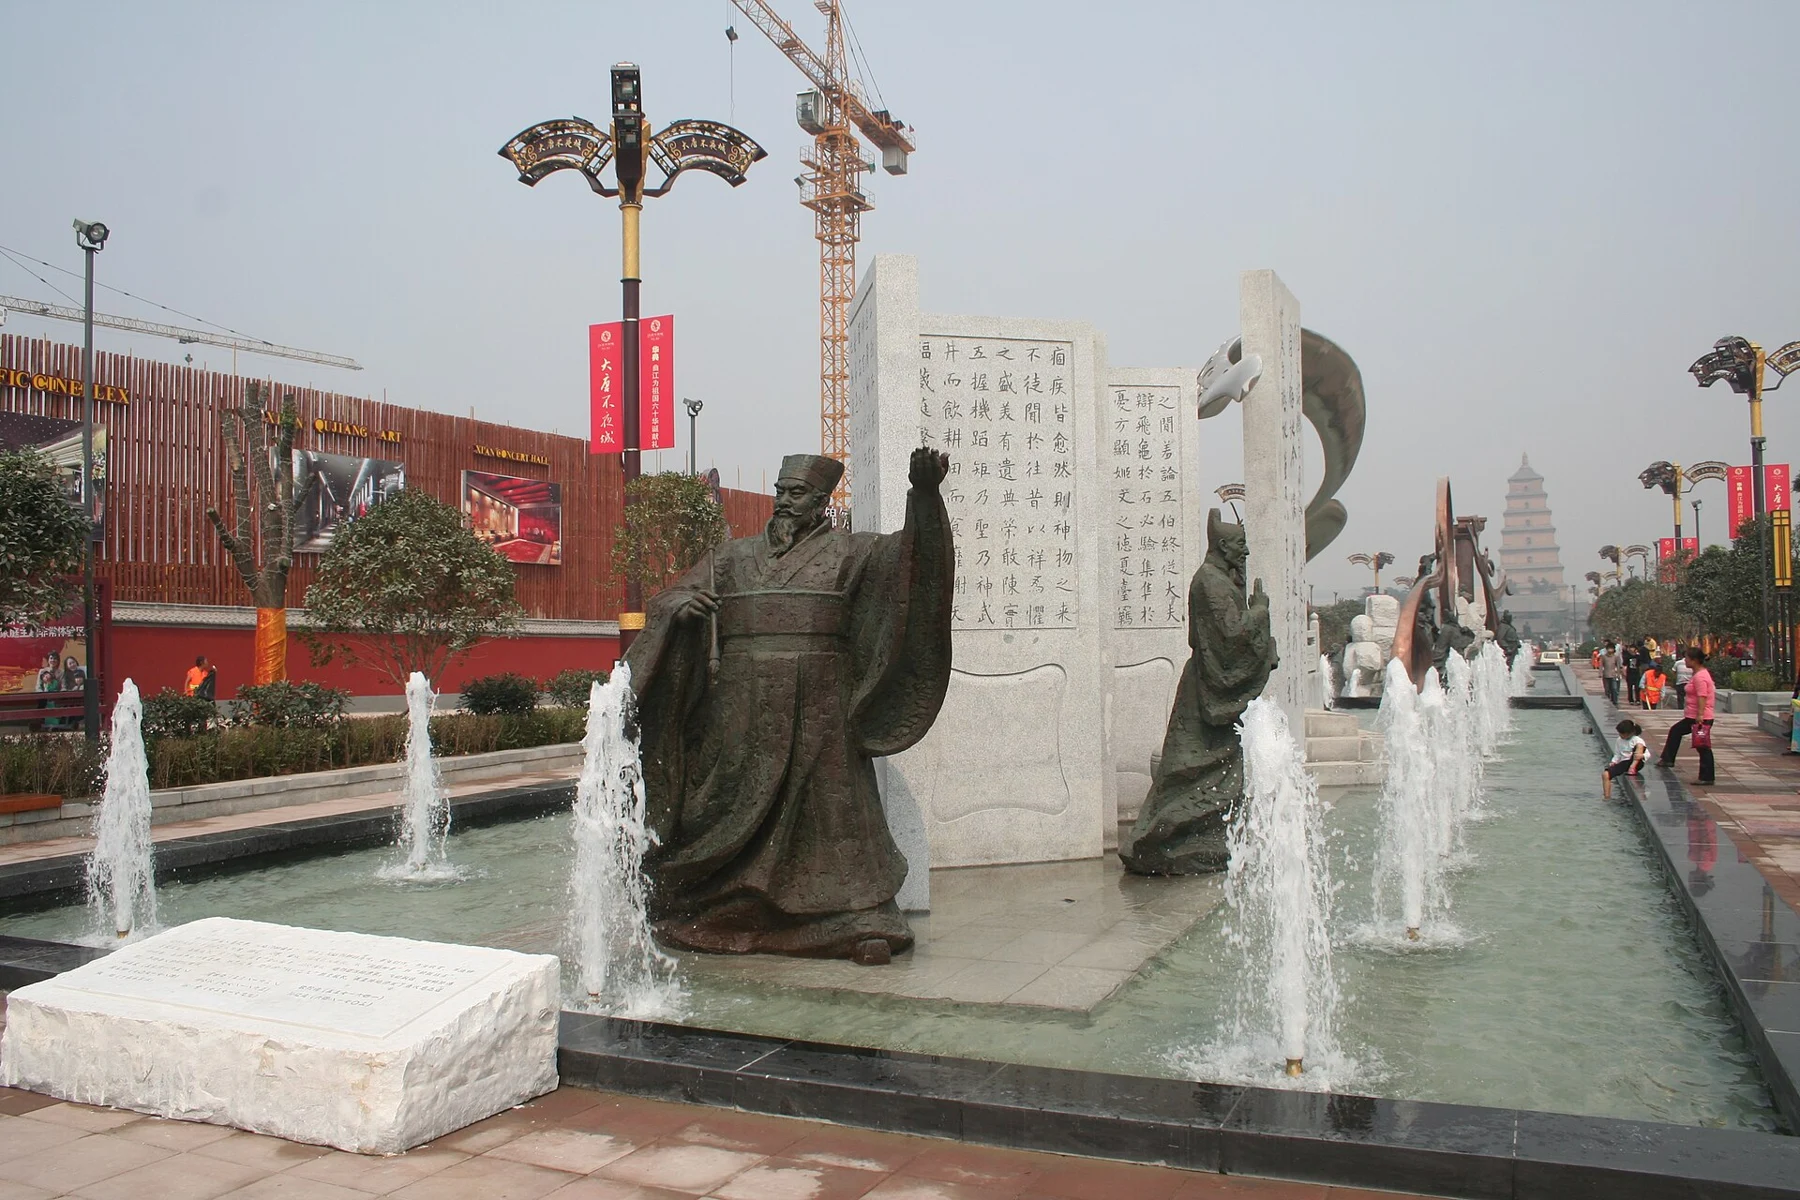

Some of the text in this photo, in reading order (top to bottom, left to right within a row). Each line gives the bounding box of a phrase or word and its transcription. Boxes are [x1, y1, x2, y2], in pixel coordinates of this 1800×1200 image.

[33, 373, 130, 405] CINELEX
[600, 358, 615, 444] 大唐不夜城
[314, 417, 368, 438] QUJIANG
[379, 429, 402, 443] ART
[496, 447, 529, 463] CONCERT
[530, 454, 549, 465] HALL
